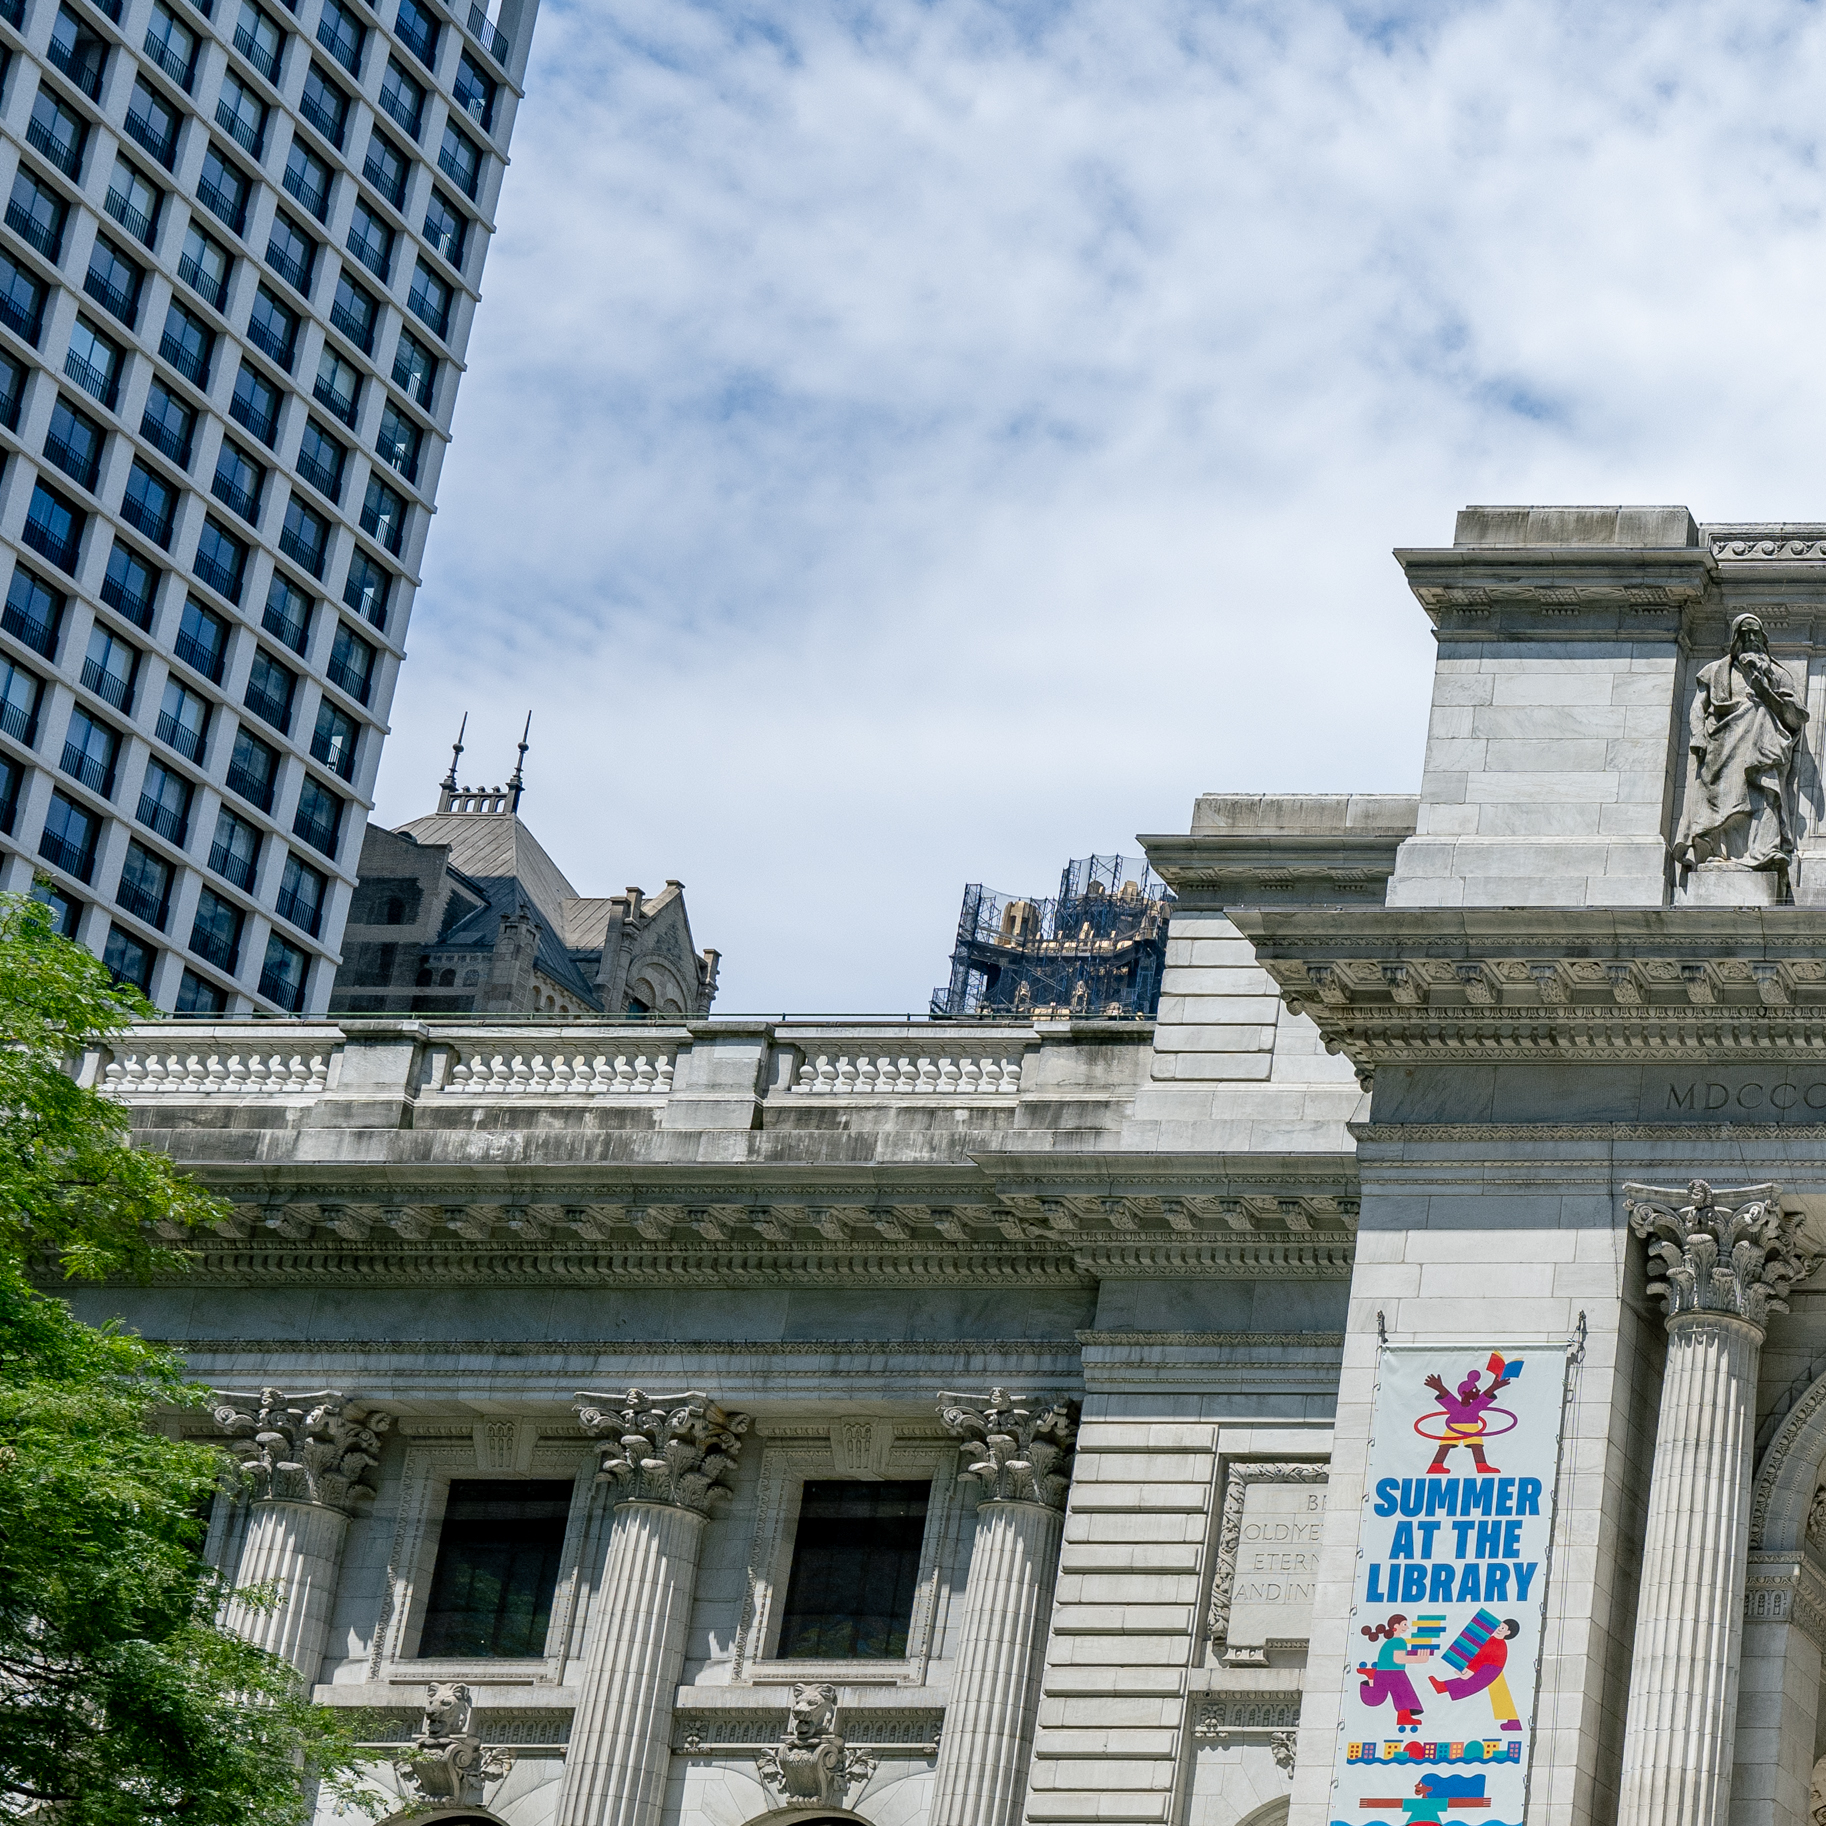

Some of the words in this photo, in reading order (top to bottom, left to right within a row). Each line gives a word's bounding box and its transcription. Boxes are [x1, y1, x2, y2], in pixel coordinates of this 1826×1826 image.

[1374, 1477, 1542, 1517] SUMMER
[1244, 1524, 1289, 1540] OLD
[1294, 1524, 1324, 1540] YE
[1389, 1520, 1441, 1560] AT
[1452, 1520, 1523, 1560] THE
[1234, 1583, 1282, 1601] AND
[1366, 1562, 1538, 1602] LIBRARY
